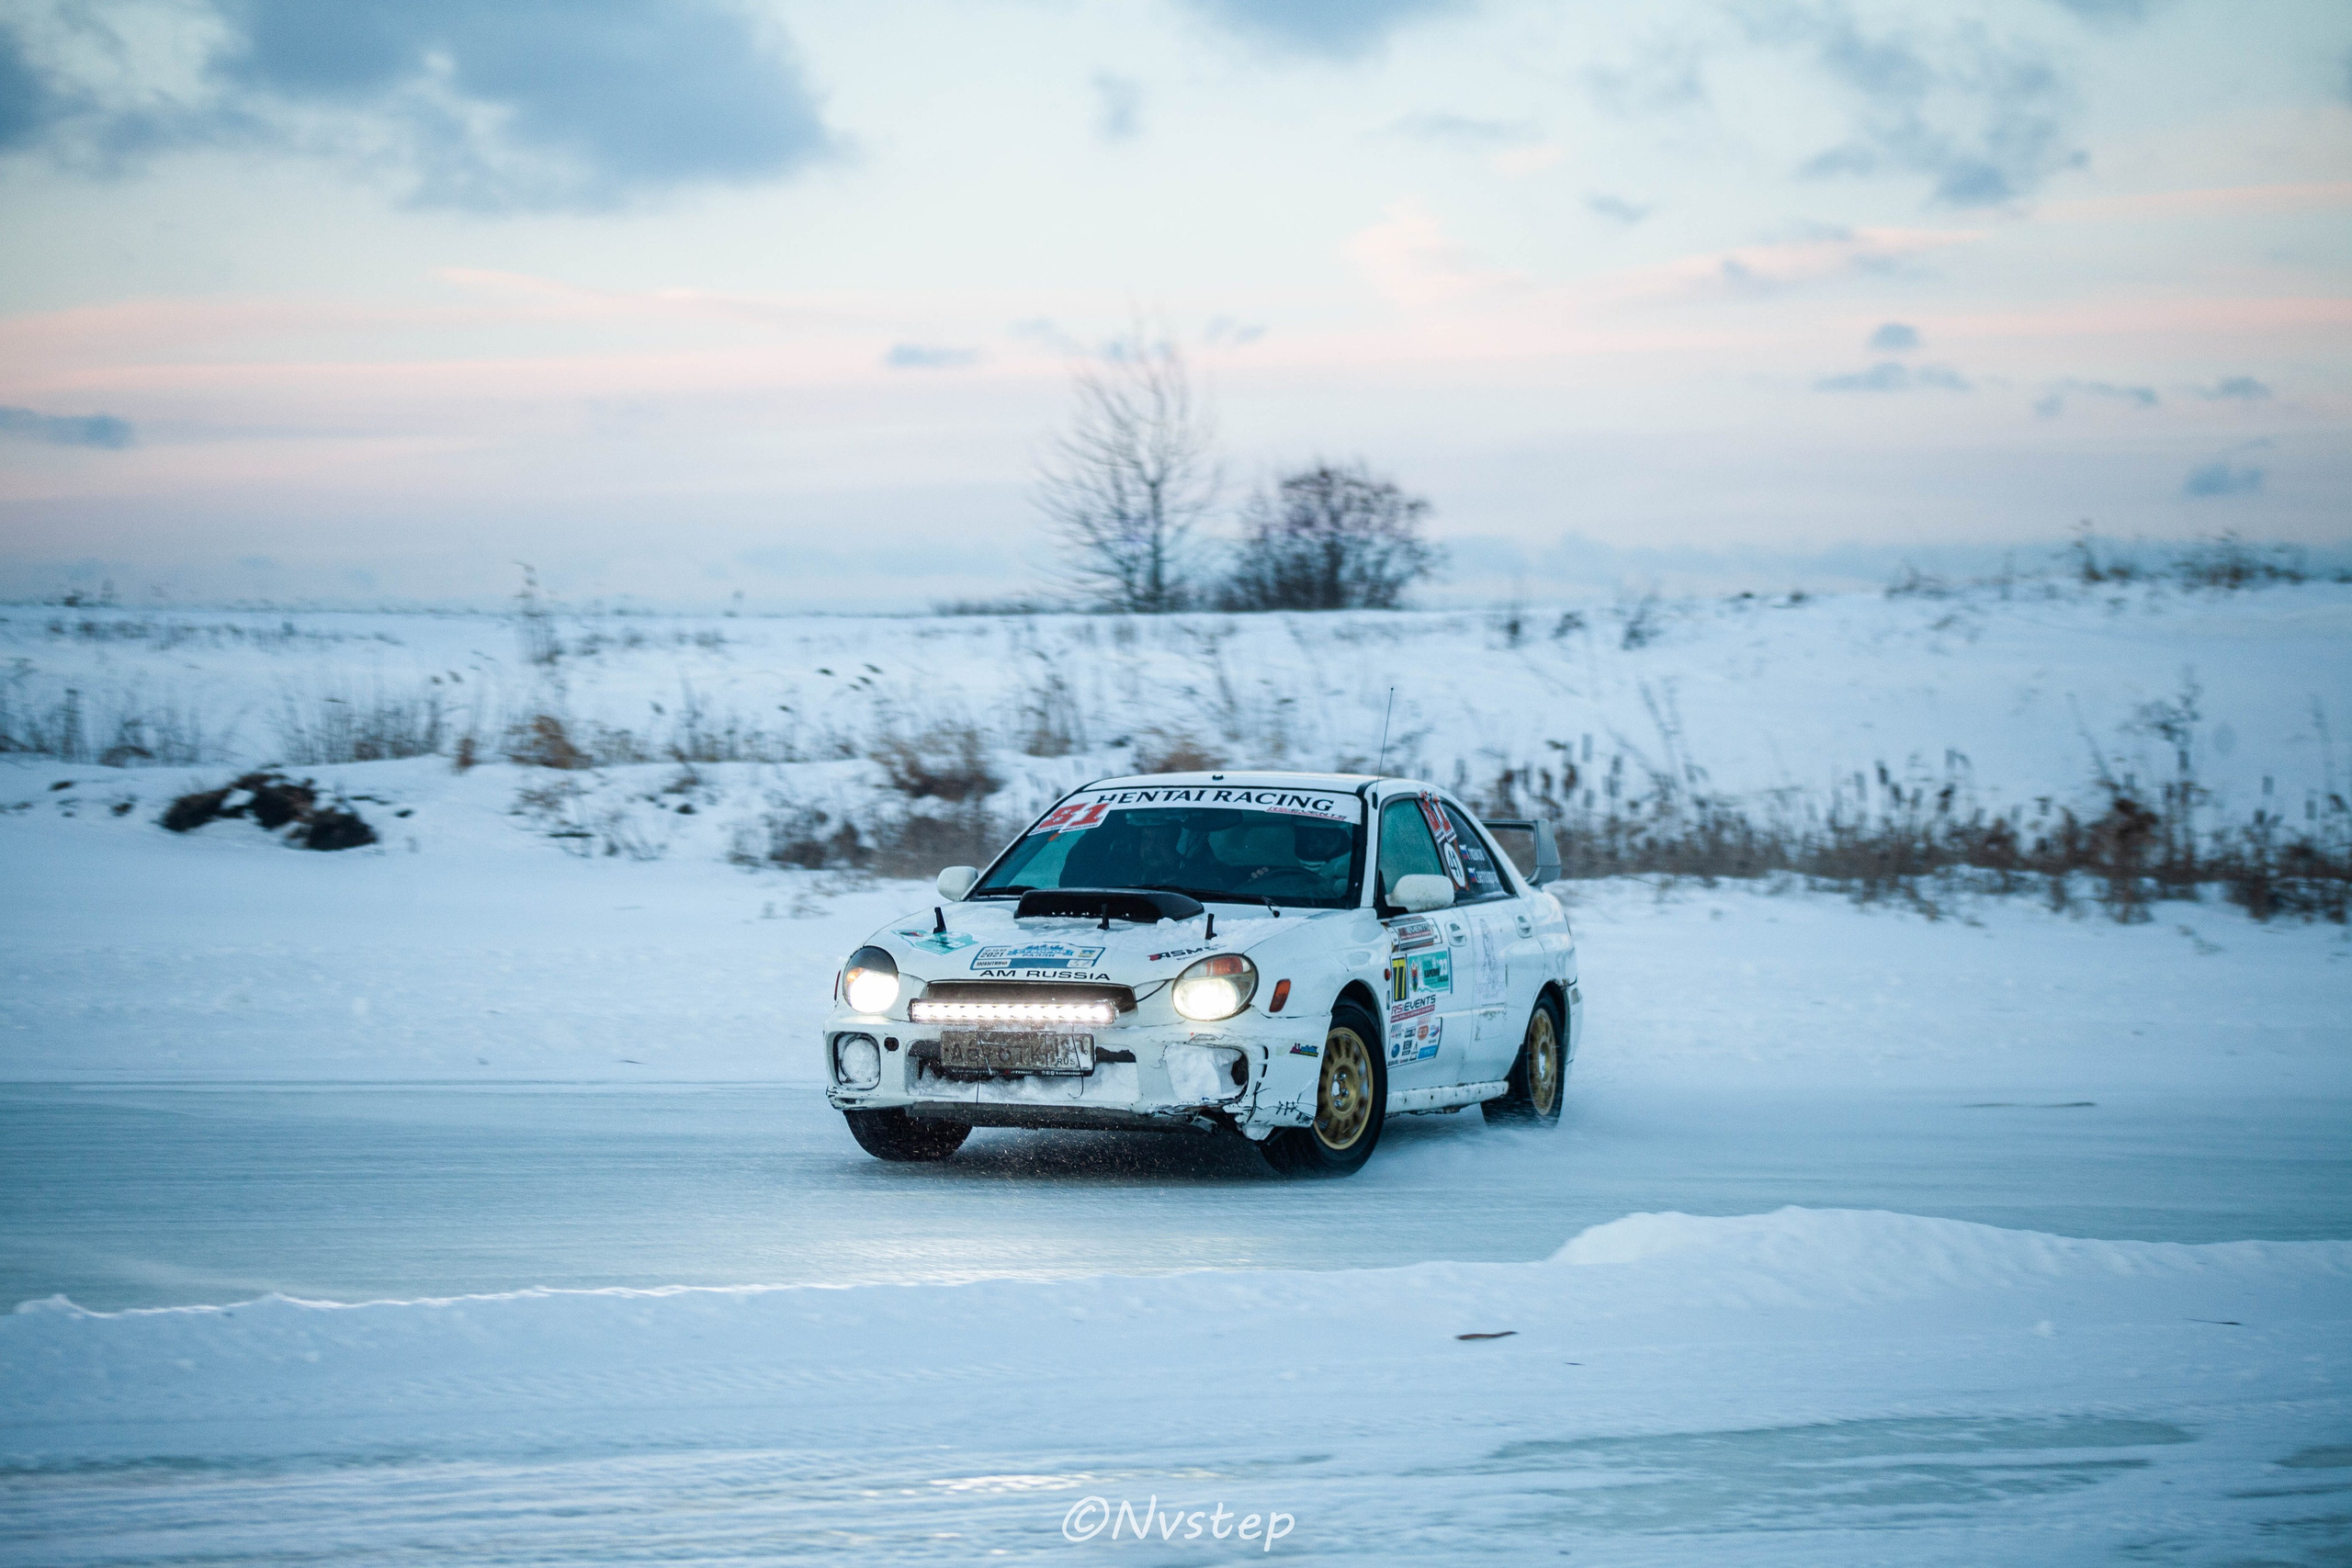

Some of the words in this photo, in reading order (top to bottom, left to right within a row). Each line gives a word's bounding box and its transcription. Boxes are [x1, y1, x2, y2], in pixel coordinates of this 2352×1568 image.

[1097, 790, 1207, 804] HENTAI
[1213, 790, 1334, 811] RACING
[979, 969, 1016, 977] AM
[1026, 970, 1110, 980] RUSSIA
[1404, 994, 1436, 1011] EVENTS
